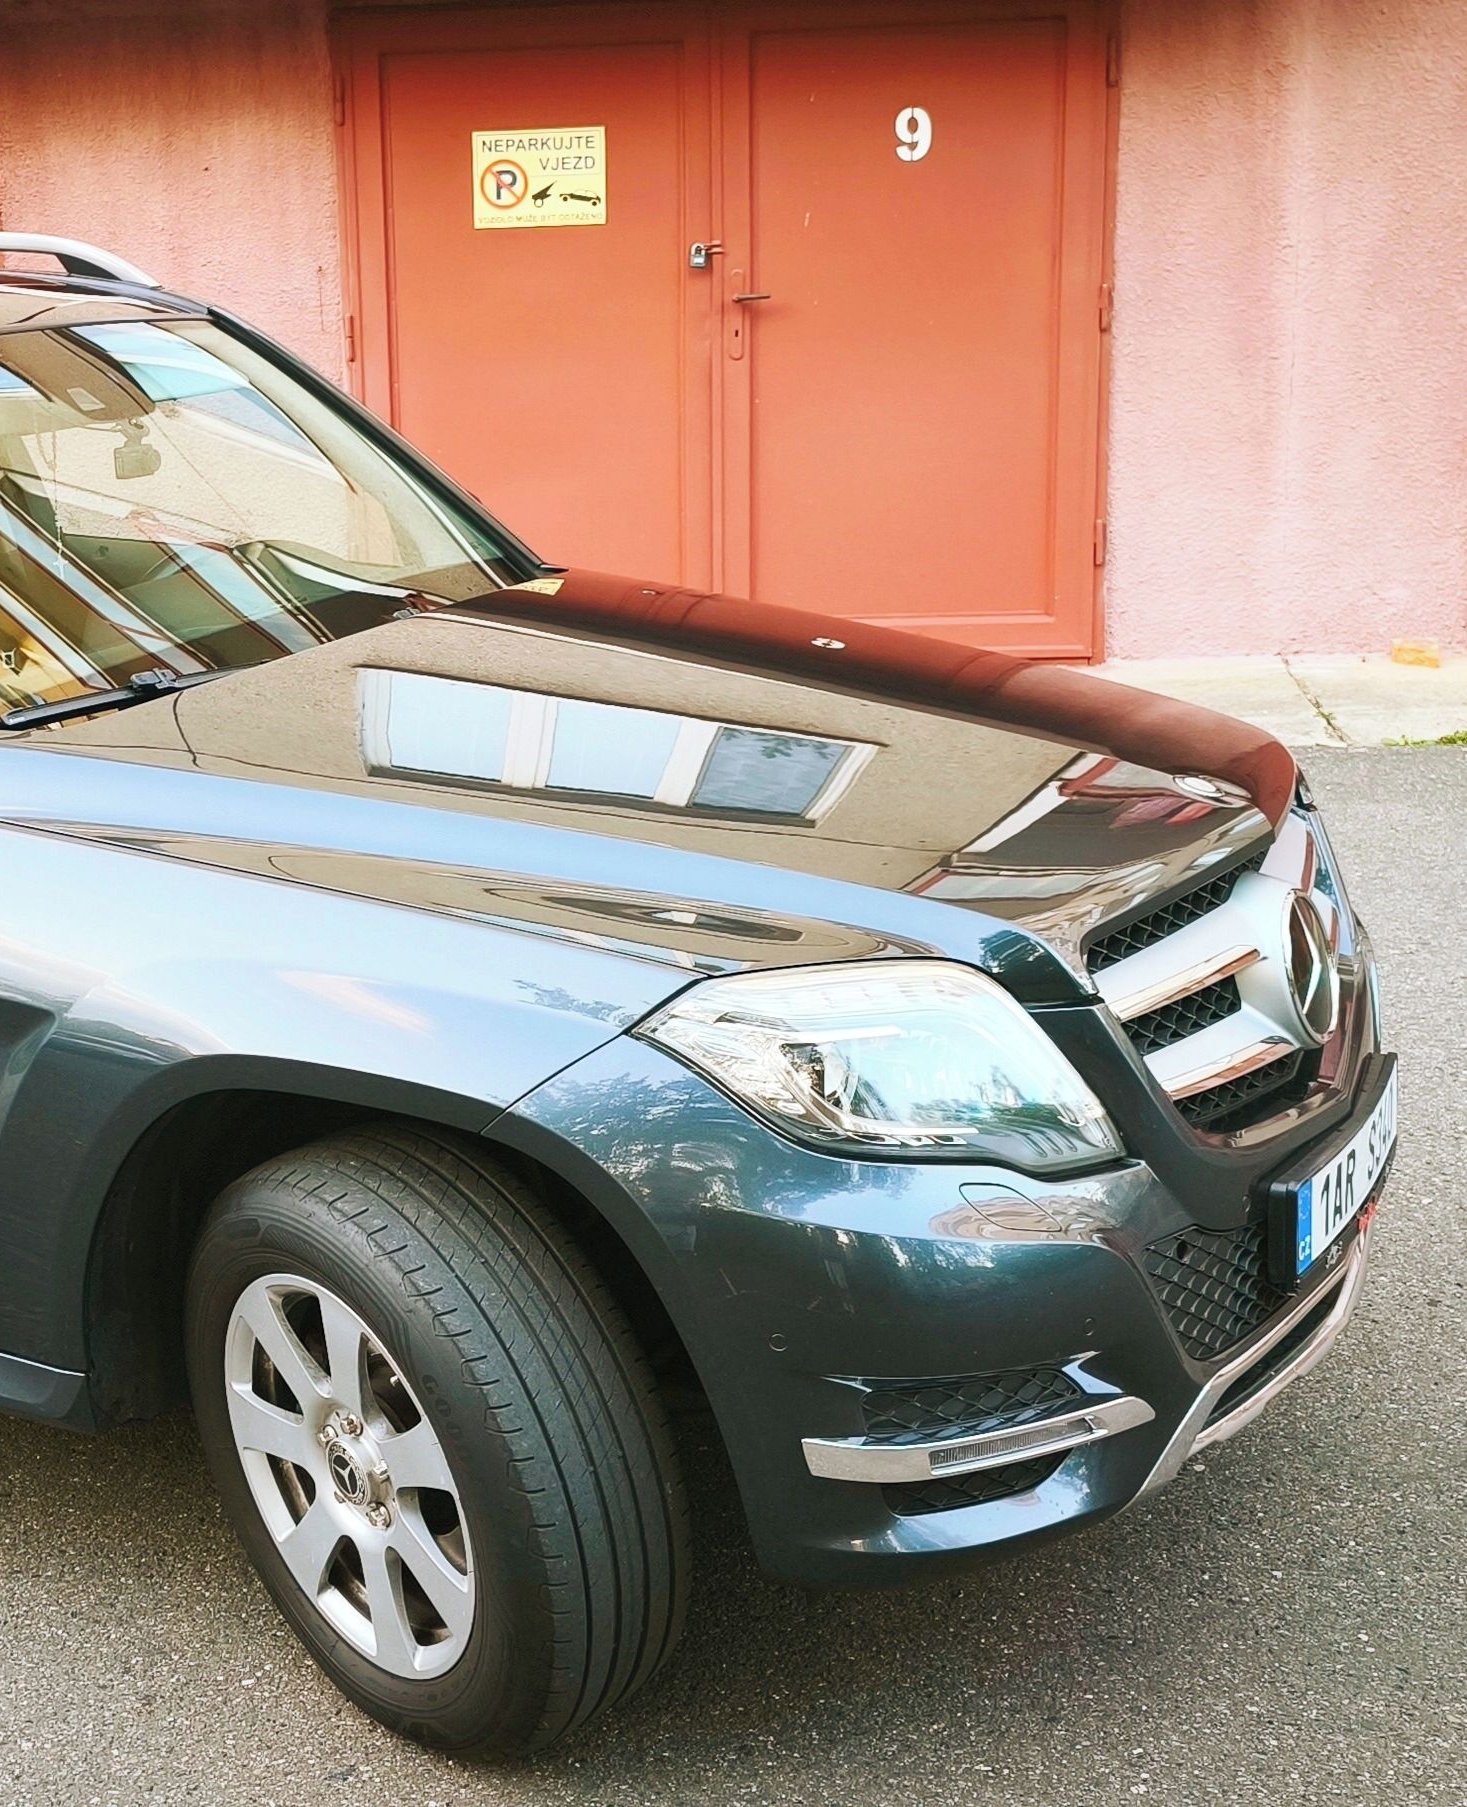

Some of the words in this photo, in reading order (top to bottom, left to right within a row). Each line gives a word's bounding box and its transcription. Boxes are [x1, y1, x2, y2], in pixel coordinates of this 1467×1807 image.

[481, 135, 596, 153] NEPARKUJTE
[894, 106, 932, 162] 9
[539, 155, 596, 171] VJEZD
[1321, 1148, 1356, 1237] 1AR
[1298, 1234, 1311, 1261] CZ
